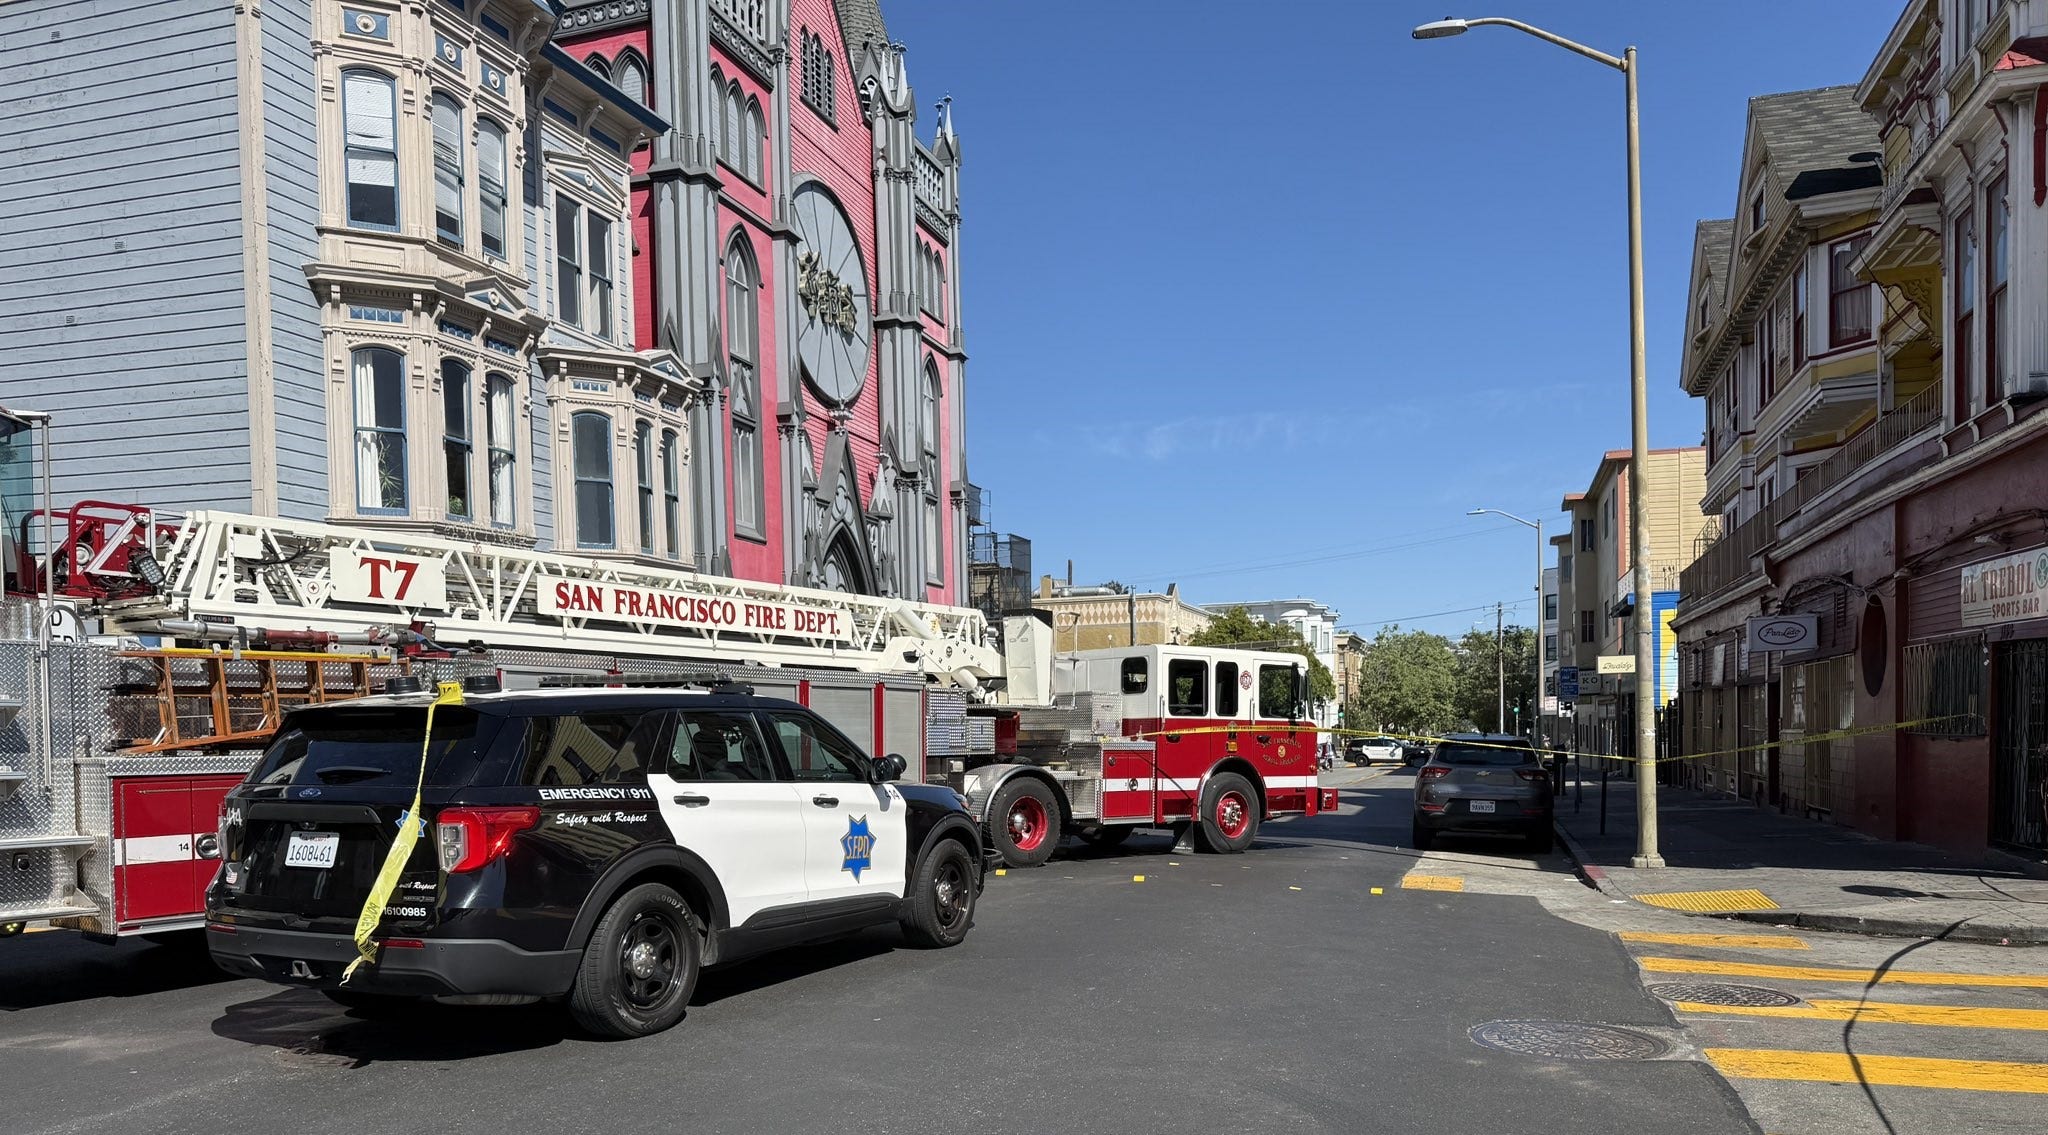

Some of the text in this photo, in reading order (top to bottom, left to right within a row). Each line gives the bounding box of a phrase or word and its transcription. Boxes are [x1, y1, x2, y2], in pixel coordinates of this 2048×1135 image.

[359, 556, 419, 601] T7
[1963, 561, 2034, 605] EL TREBOL
[556, 581, 841, 636] SAN FRANCISCO FIRE DEPT.
[1992, 597, 2040, 619] SPORTS BAR
[539, 788, 625, 800] EMERGENCY
[631, 788, 652, 799] 911
[556, 811, 648, 827] Safety with Respect
[178, 842, 190, 852] 14
[289, 845, 333, 863] 1608461
[412, 881, 437, 891] Respect
